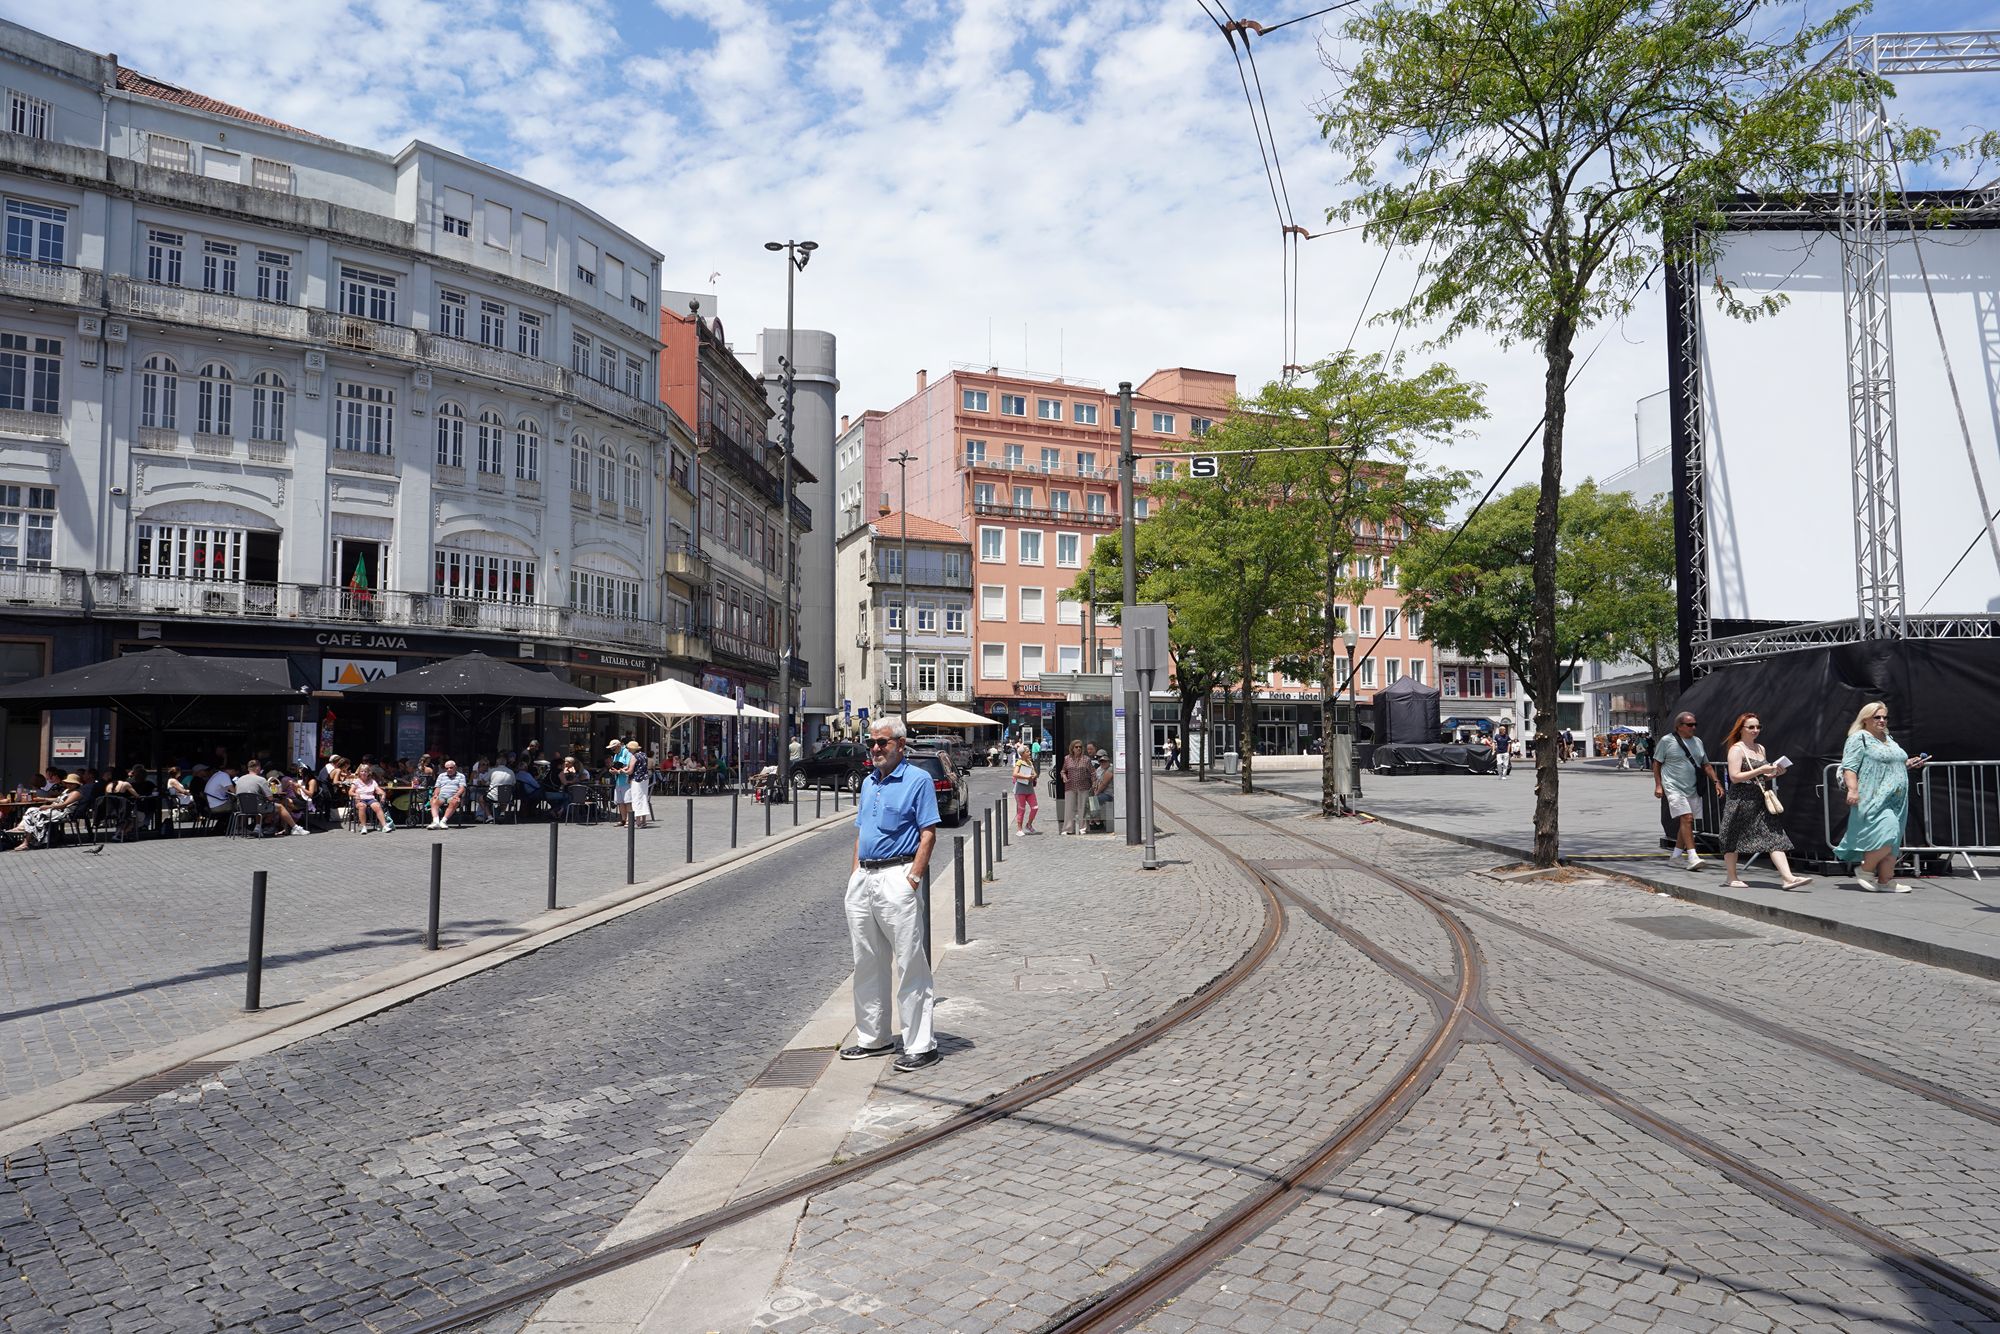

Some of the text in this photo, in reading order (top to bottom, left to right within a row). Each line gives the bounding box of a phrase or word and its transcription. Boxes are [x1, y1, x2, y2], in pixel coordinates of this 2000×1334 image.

[1192, 457, 1216, 477] S
[316, 632, 408, 649] CAFÉ JAVA
[600, 655, 629, 667] BATALHA
[630, 659, 646, 669] CAFÉ
[1269, 691, 1291, 700] Porto
[1298, 691, 1321, 700] Hotel
